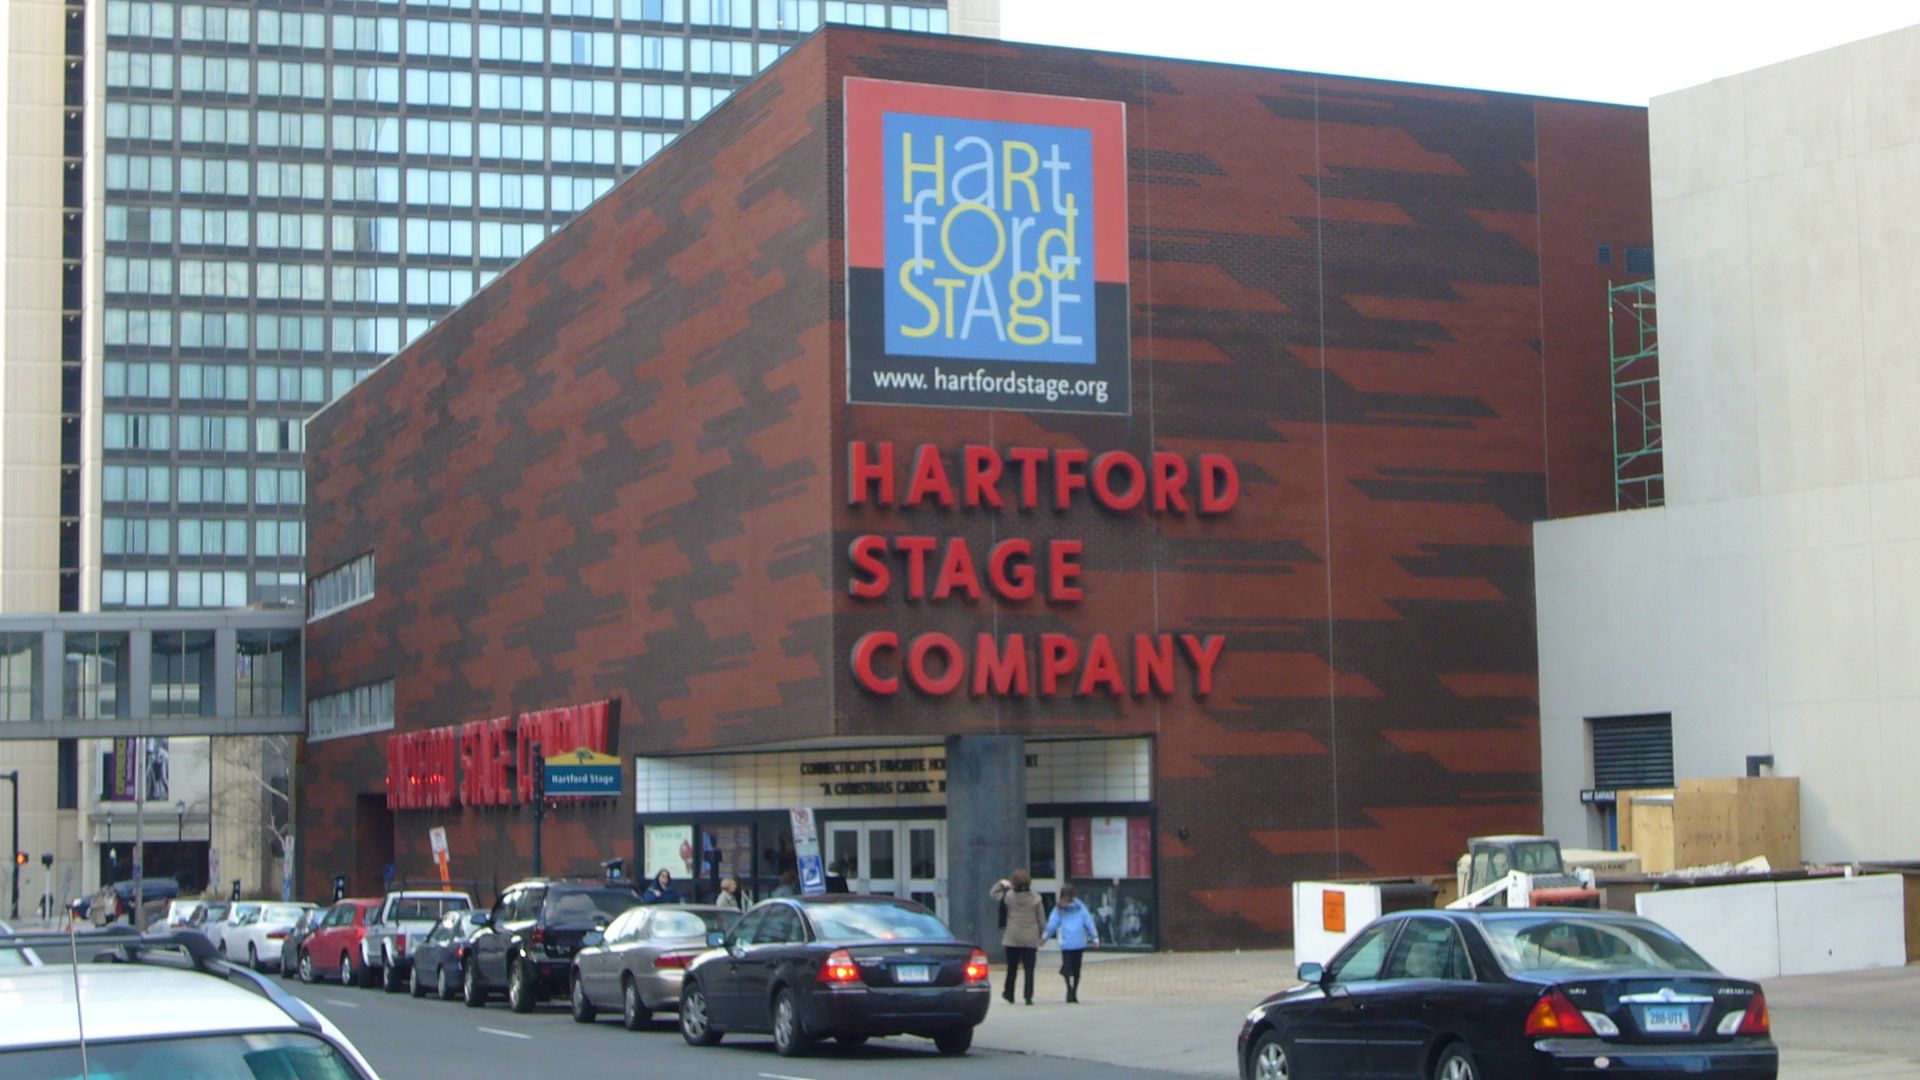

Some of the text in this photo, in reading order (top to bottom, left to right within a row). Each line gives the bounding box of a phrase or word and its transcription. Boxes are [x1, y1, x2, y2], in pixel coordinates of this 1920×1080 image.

[873, 366, 1109, 403] www. hartfordstage.org
[848, 441, 1241, 513] HARTFORD
[849, 534, 1085, 602] STAGE
[850, 630, 1227, 697] COMPANY
[551, 773, 614, 786] Hartford Stage
[835, 781, 893, 795] CHRISTMAS
